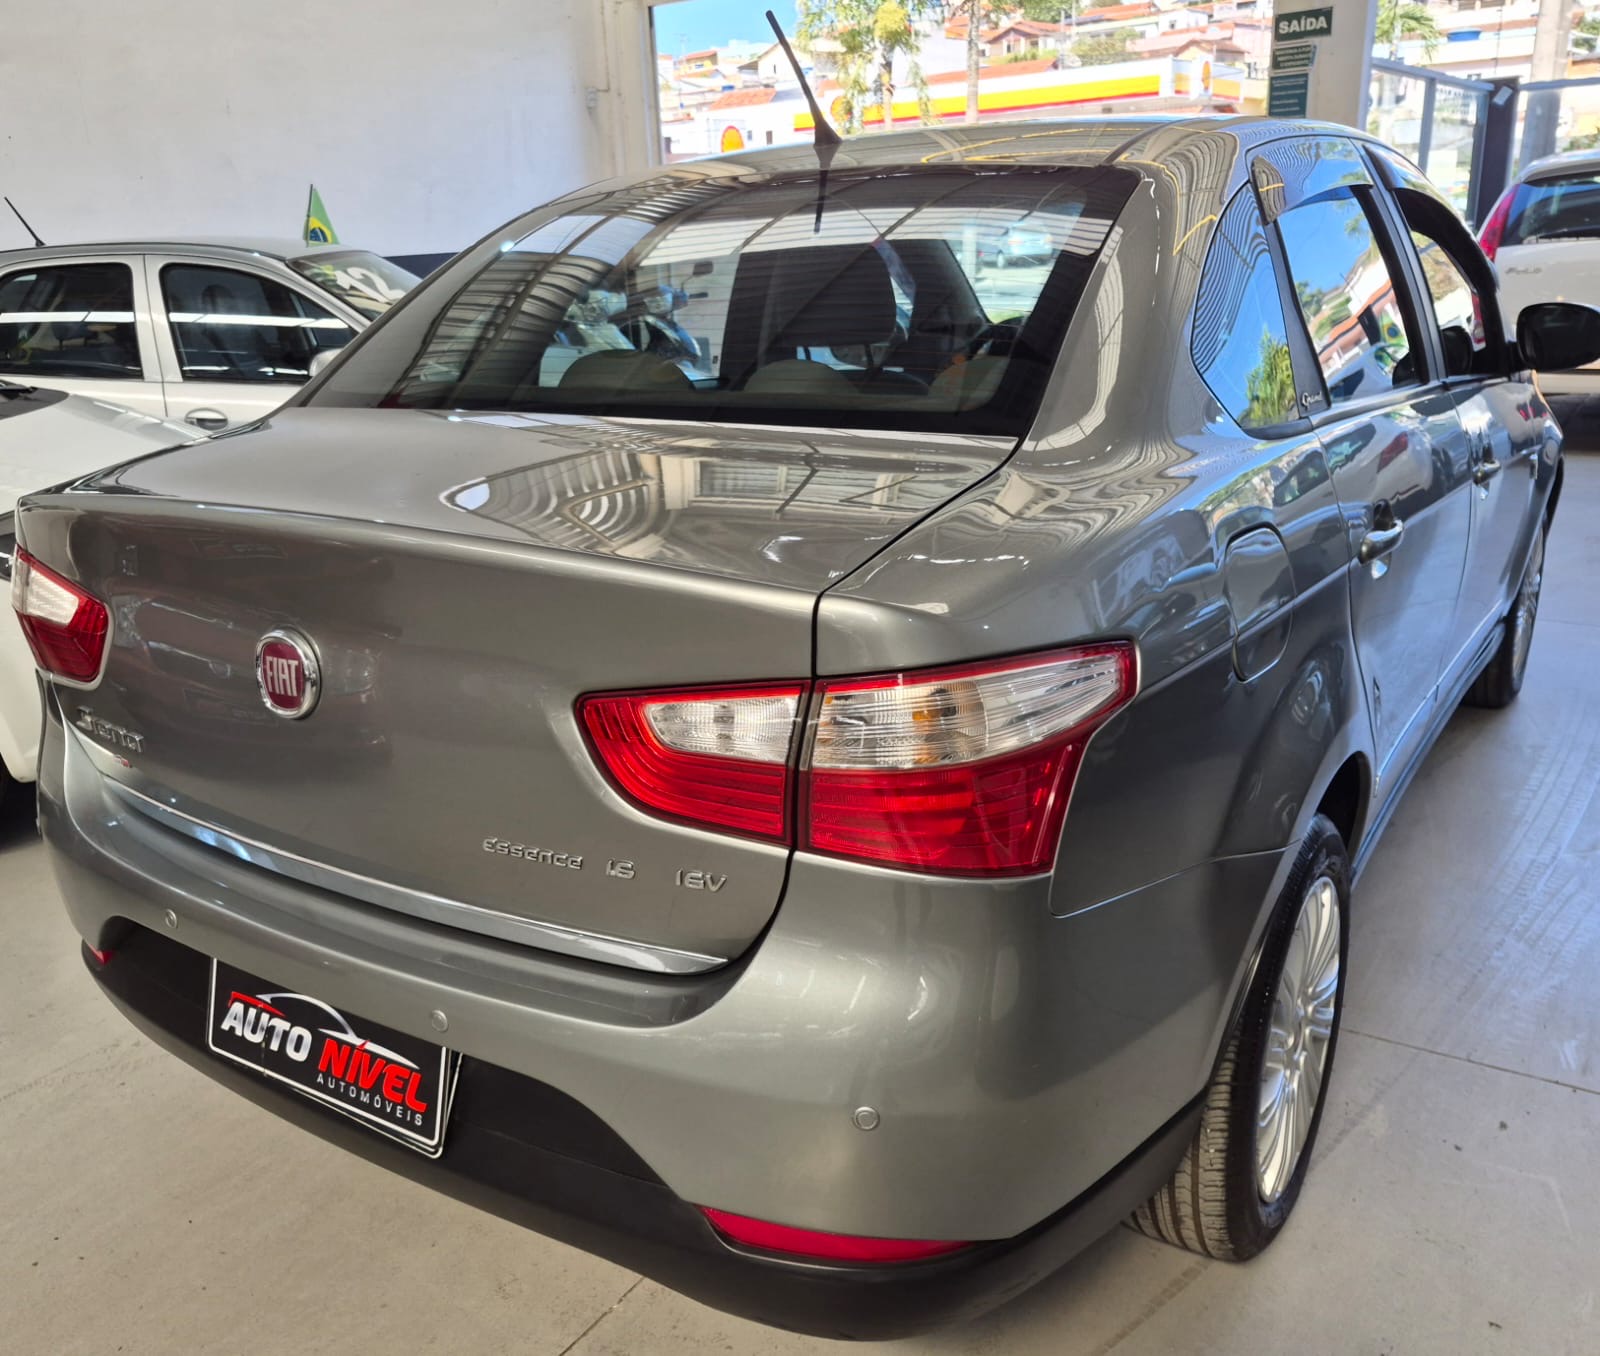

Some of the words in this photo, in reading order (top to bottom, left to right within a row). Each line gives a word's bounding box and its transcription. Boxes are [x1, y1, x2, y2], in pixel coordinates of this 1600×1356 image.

[1278, 16, 1328, 34] SAÍDA
[265, 655, 299, 697] FIAT
[605, 858, 636, 880] 1.6
[674, 867, 727, 892] 16V
[220, 1001, 313, 1063] AUTO
[318, 1037, 427, 1113] NÍVEL
[316, 1072, 423, 1126] AUTOMÓVEIS
